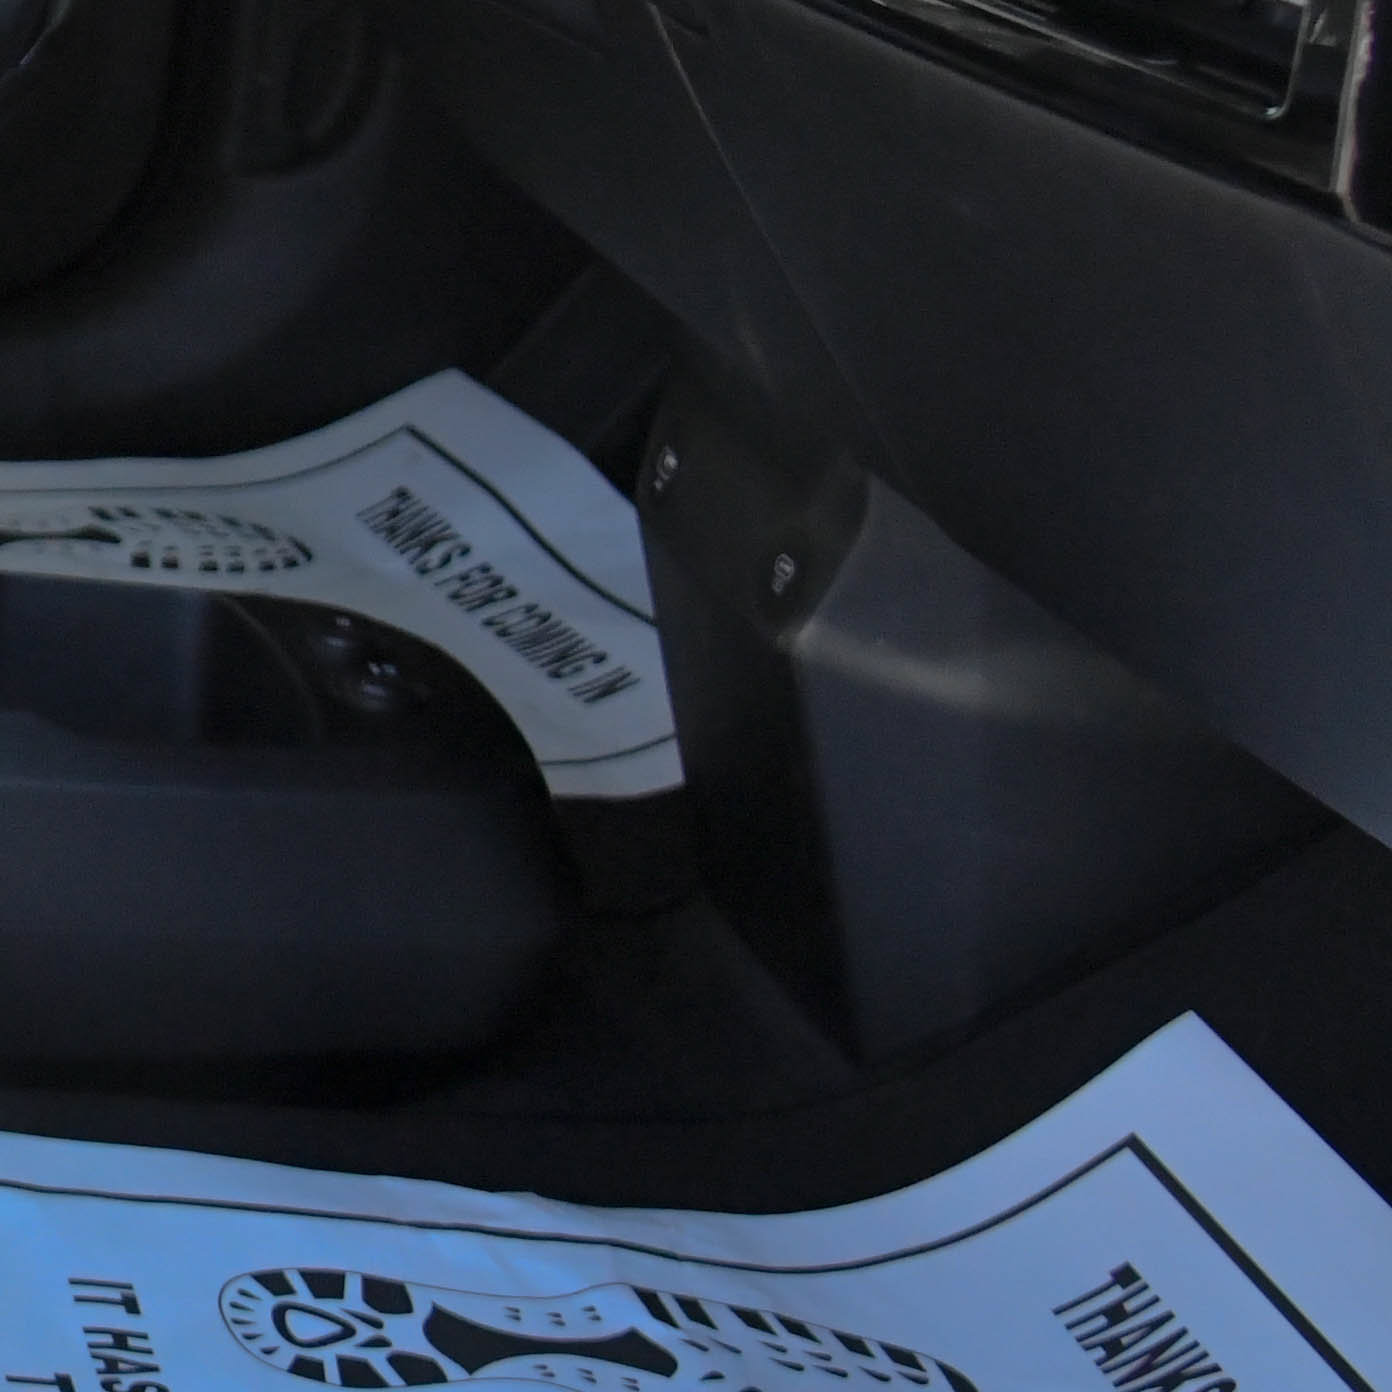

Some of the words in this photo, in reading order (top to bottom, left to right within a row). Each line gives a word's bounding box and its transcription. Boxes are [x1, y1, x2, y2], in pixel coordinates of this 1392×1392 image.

[355, 487, 471, 576] THANKS
[433, 561, 518, 613] FOR
[481, 603, 607, 679] COMING
[569, 666, 640, 704] IN
[68, 1277, 141, 1315] IT
[1051, 1261, 1237, 1392] THANK
